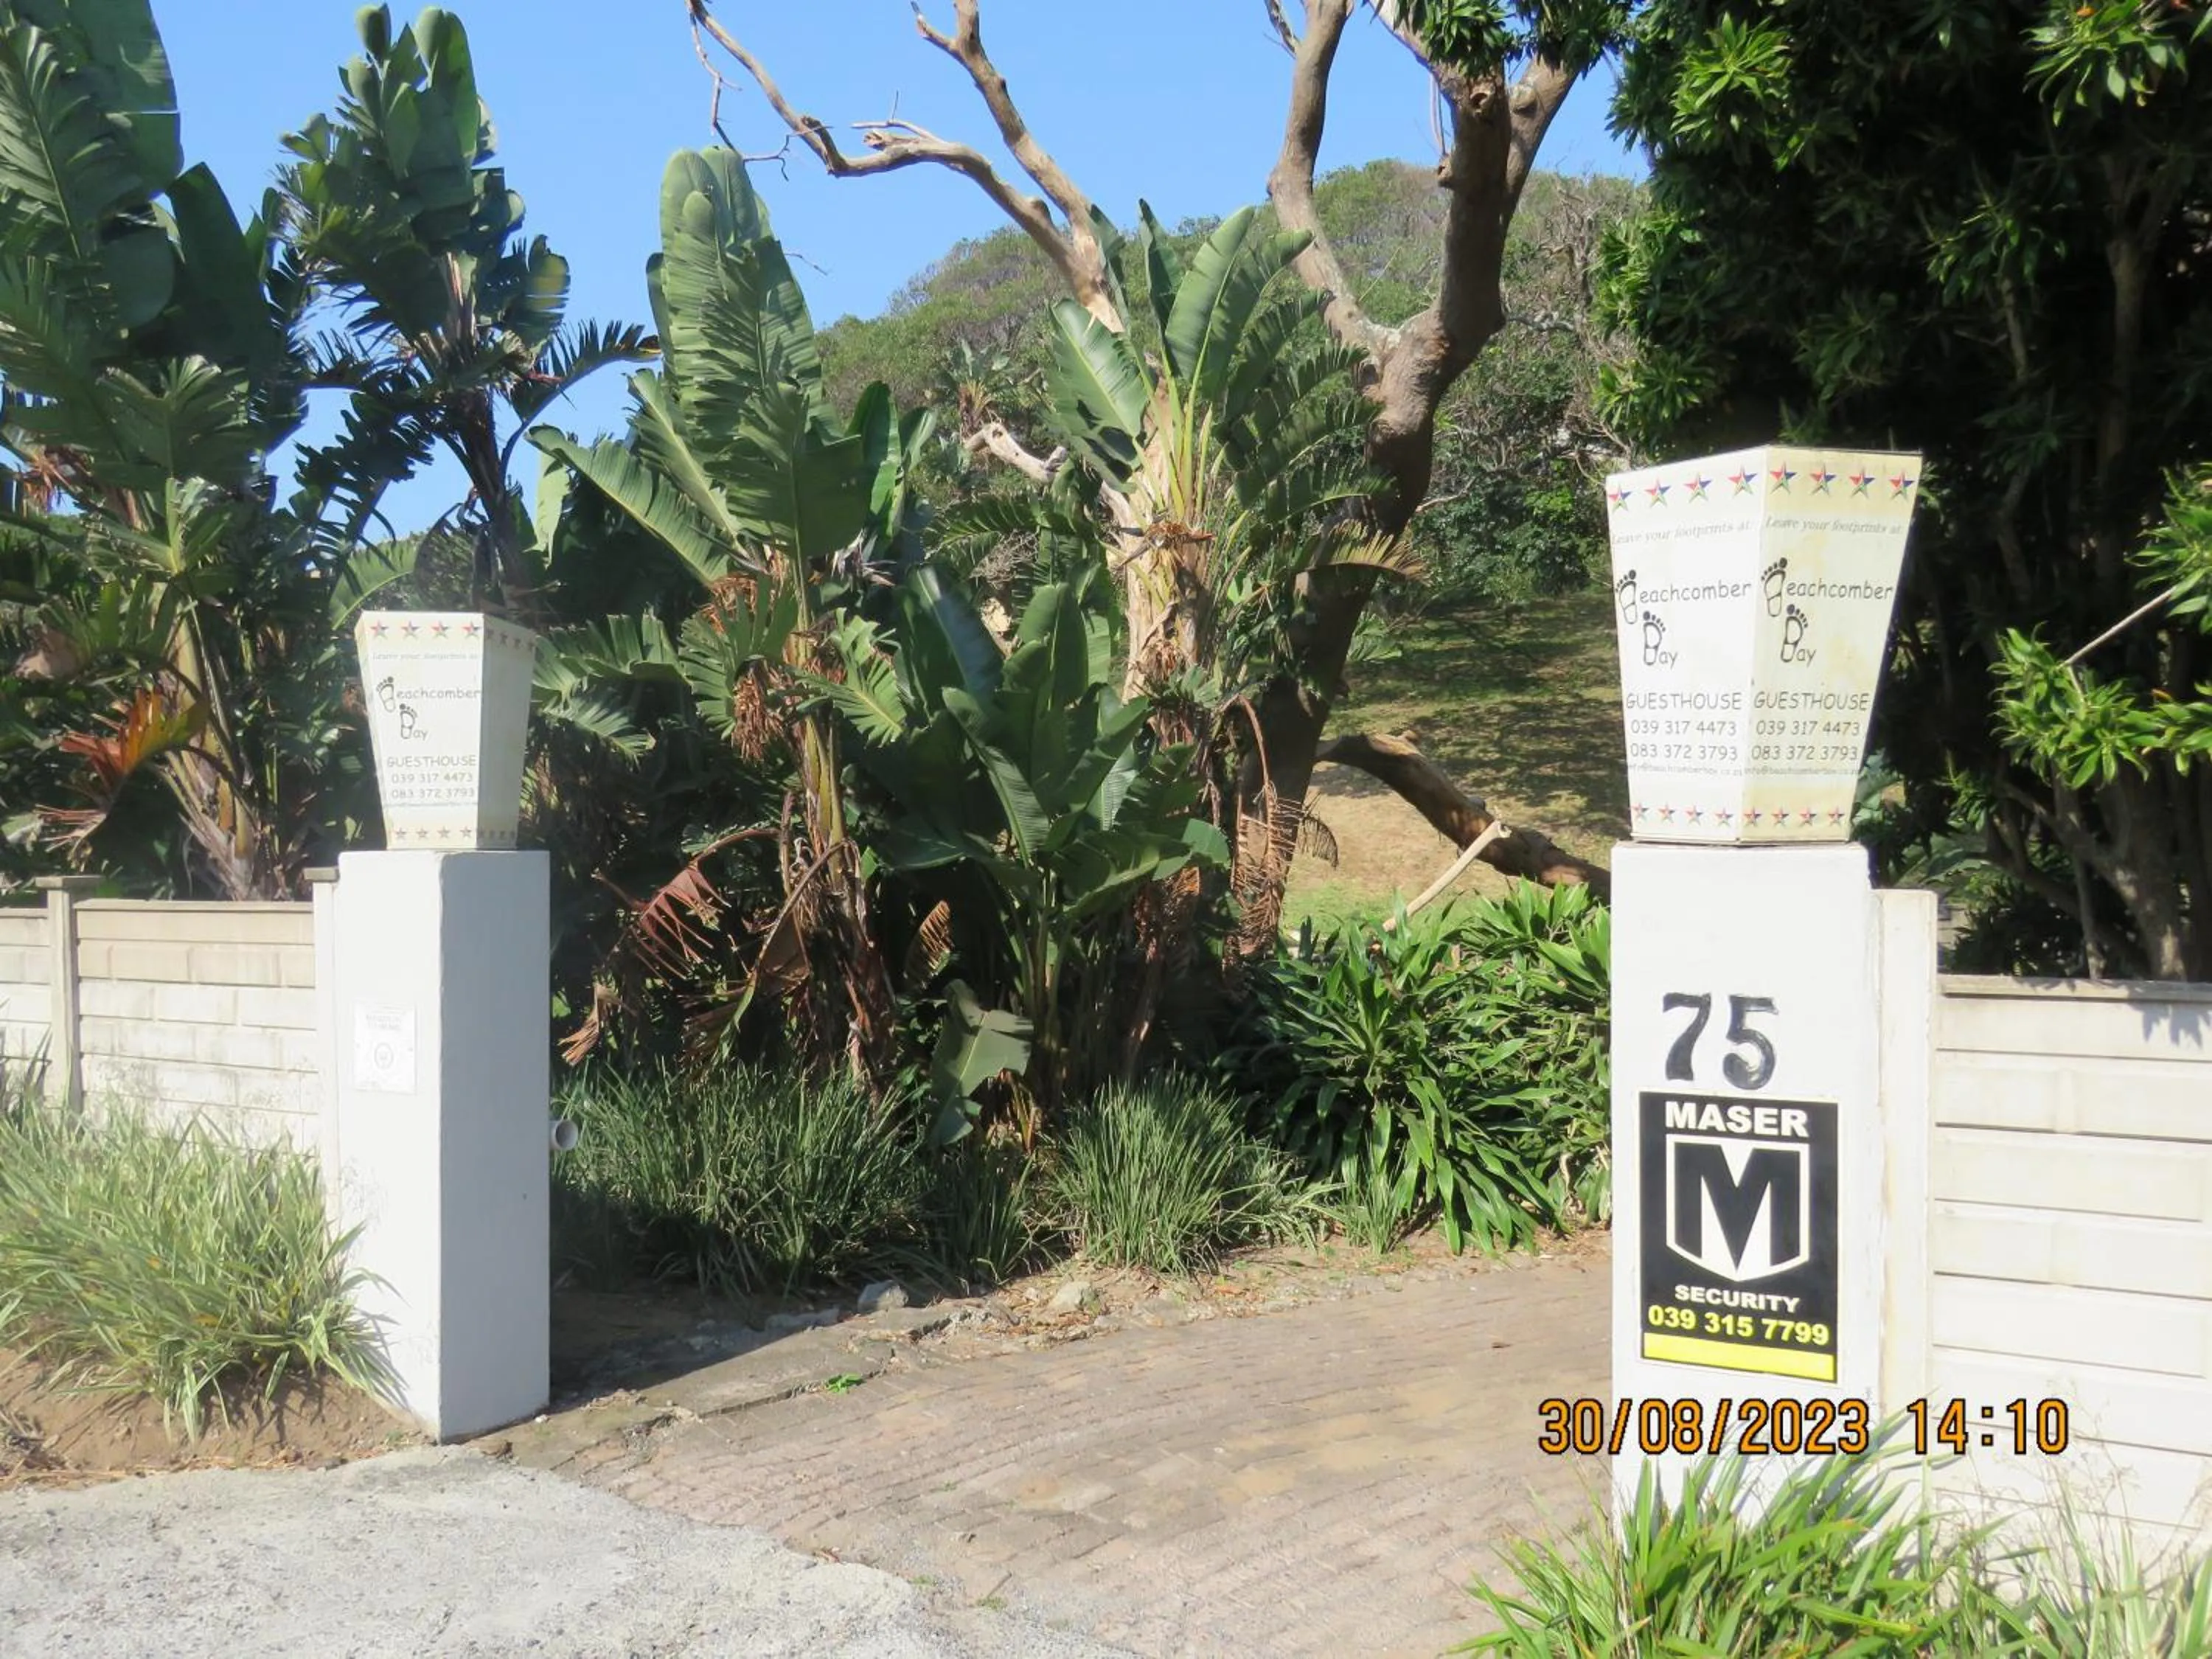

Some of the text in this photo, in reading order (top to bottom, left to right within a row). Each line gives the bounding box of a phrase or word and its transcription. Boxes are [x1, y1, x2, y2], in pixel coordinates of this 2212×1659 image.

[1626, 692, 1742, 710] GUESTHOUSE
[1753, 691, 1871, 712] GUESTHOUSE
[1630, 719, 1737, 737] 039 317 4473
[1756, 719, 1860, 737] 039 317 4473
[1630, 742, 1739, 761] 083 372 3793
[1751, 745, 1858, 761] 083 372 3793
[387, 754, 478, 768] GUESTHOUSE
[391, 771, 473, 784] 039 317 4473
[419, 787, 442, 799] 372
[1662, 992, 1779, 1091] 75
[1665, 1100, 1809, 1138] MASER
[1674, 1283, 1801, 1315] SECURITY
[1647, 1304, 1830, 1347] 039 315 7799
